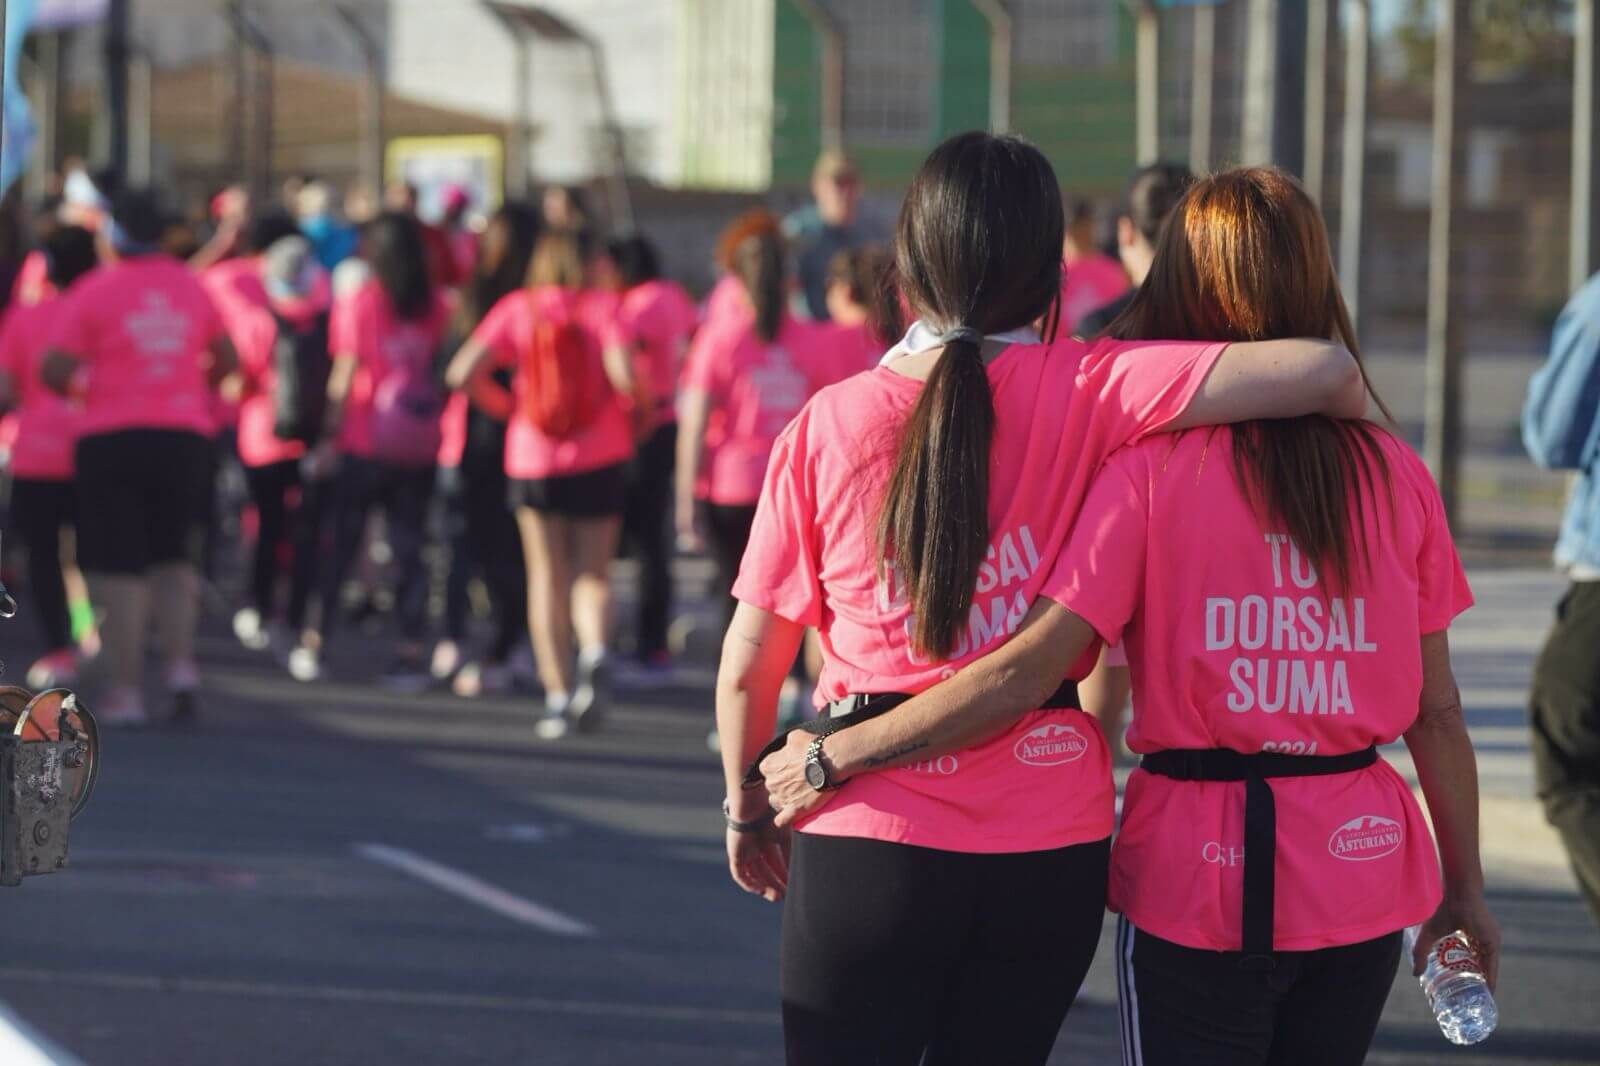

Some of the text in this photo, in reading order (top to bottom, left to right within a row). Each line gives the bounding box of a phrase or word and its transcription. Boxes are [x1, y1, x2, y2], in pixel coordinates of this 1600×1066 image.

[879, 525, 1040, 612] DSAL
[1264, 533, 1318, 589] TU
[1205, 595, 1377, 652] DORSAL
[1227, 657, 1355, 714] SUMA
[1335, 831, 1399, 854] ASTURIANA
